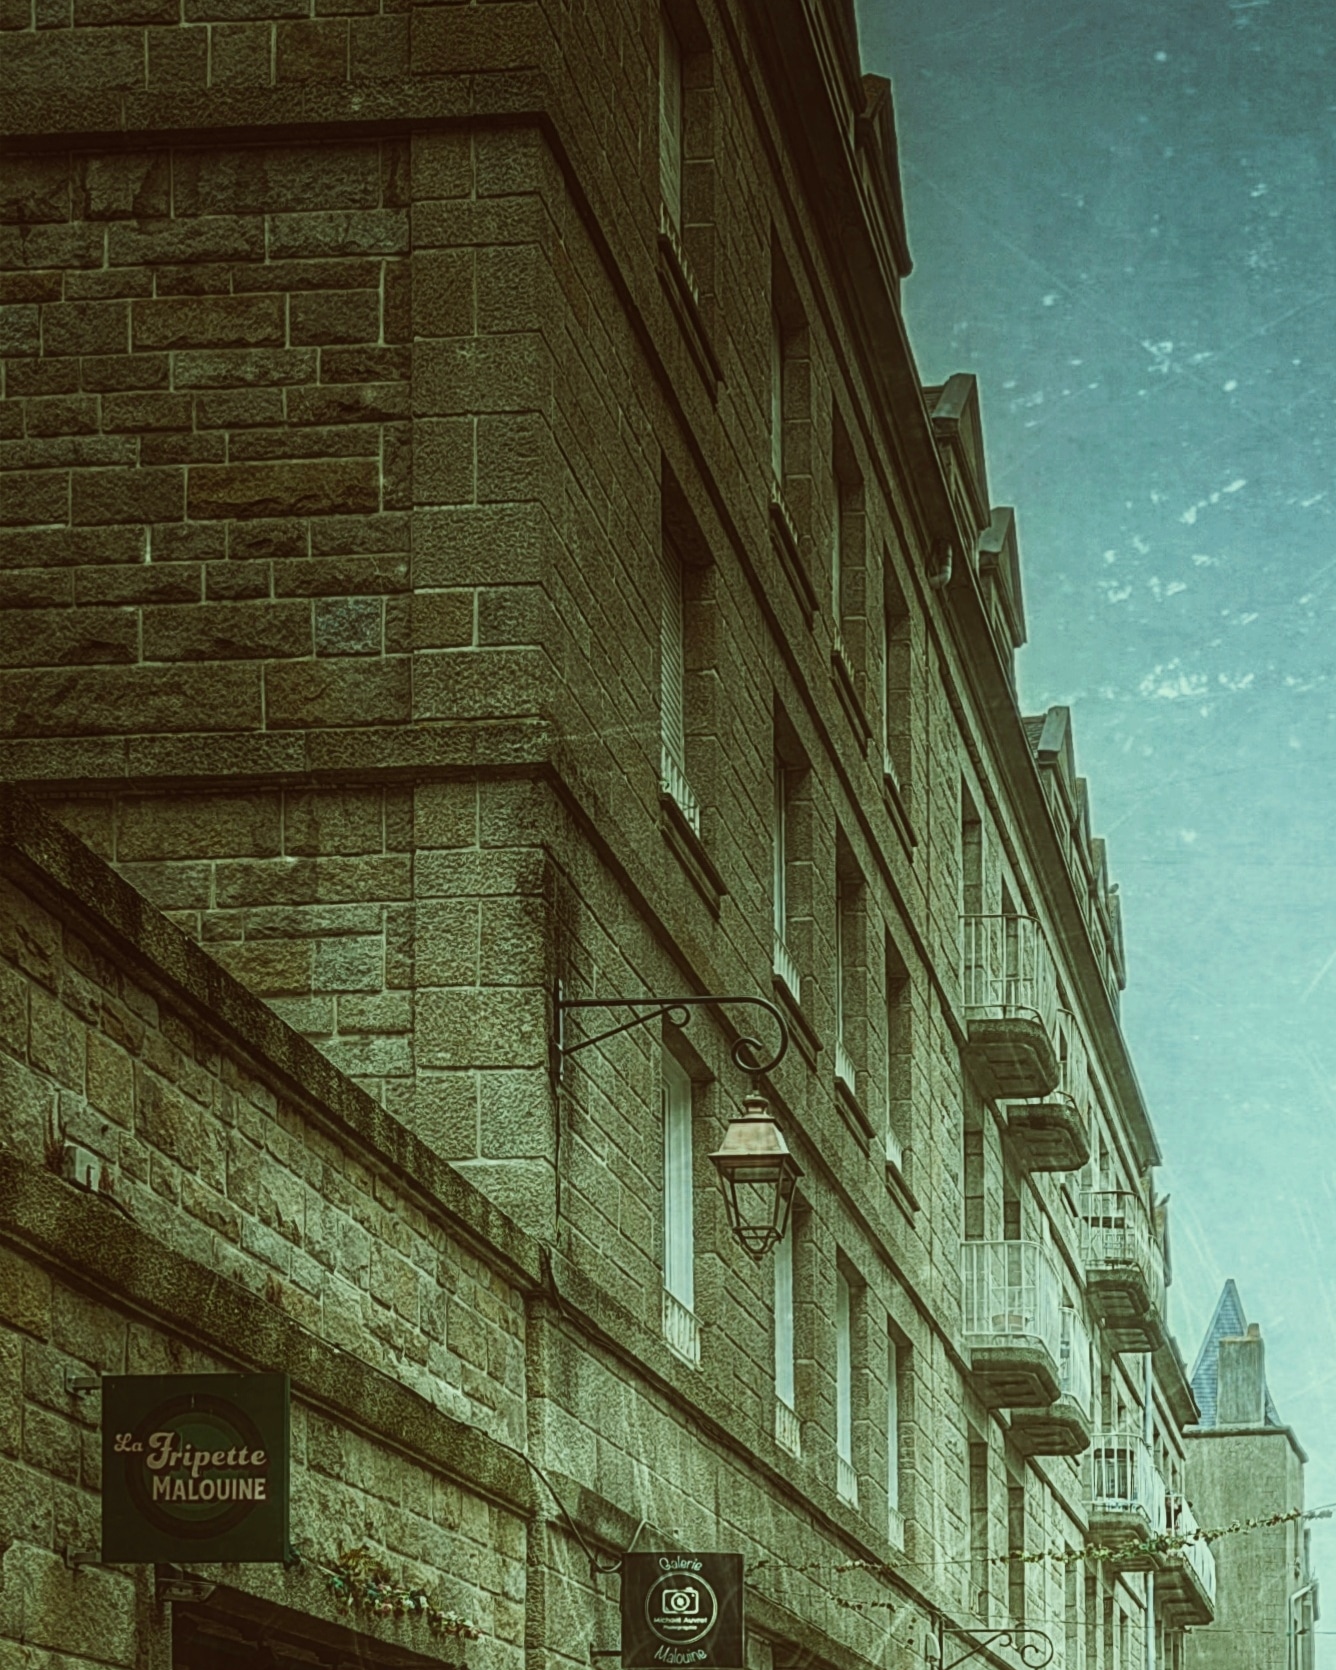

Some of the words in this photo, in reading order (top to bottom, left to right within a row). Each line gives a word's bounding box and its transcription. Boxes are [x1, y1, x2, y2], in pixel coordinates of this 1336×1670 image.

[114, 1433, 143, 1451] La
[147, 1432, 266, 1477] Fripette
[153, 1476, 266, 1500] MALOUINE
[659, 1556, 702, 1570] Galerie
[654, 1645, 707, 1664] Malouine
